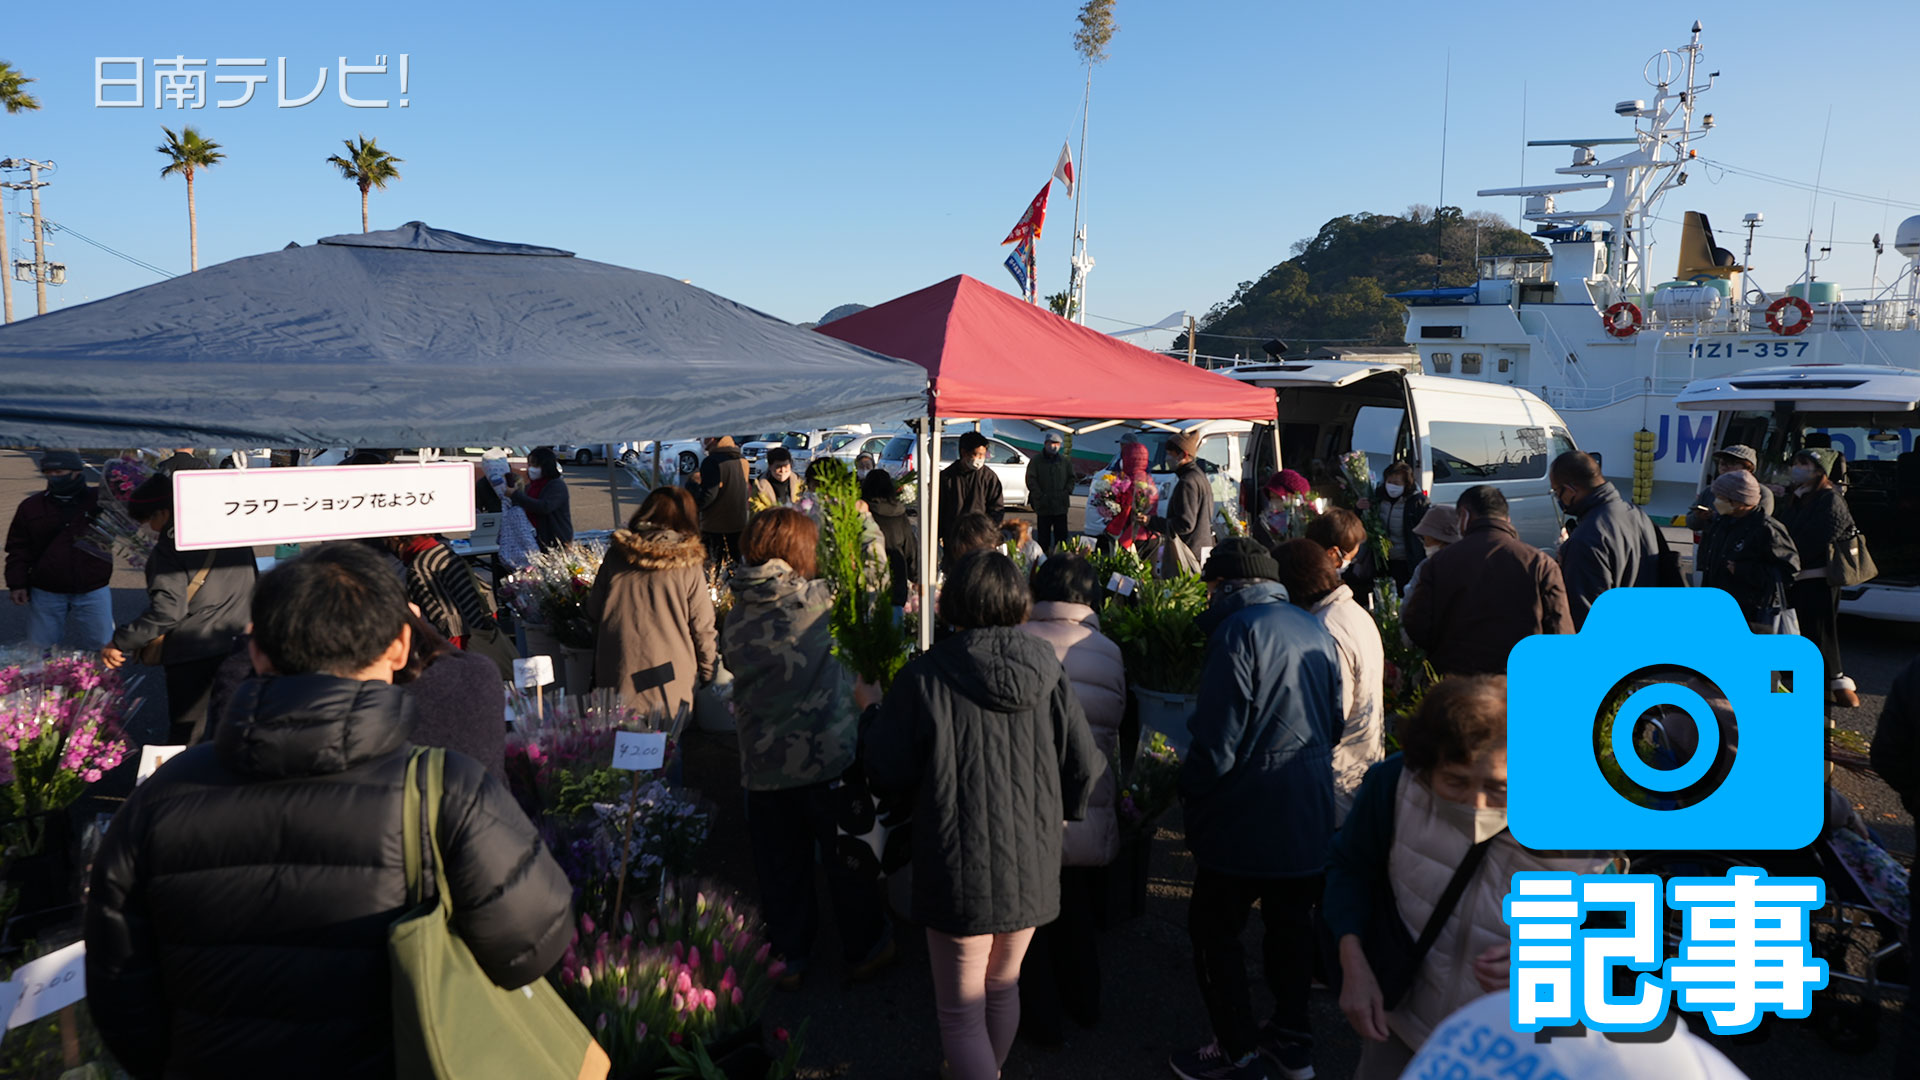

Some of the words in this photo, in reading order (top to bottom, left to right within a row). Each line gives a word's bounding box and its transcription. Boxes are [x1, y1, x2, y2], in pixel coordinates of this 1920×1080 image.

[224, 490, 435, 516] フラワーショップ花ようび
